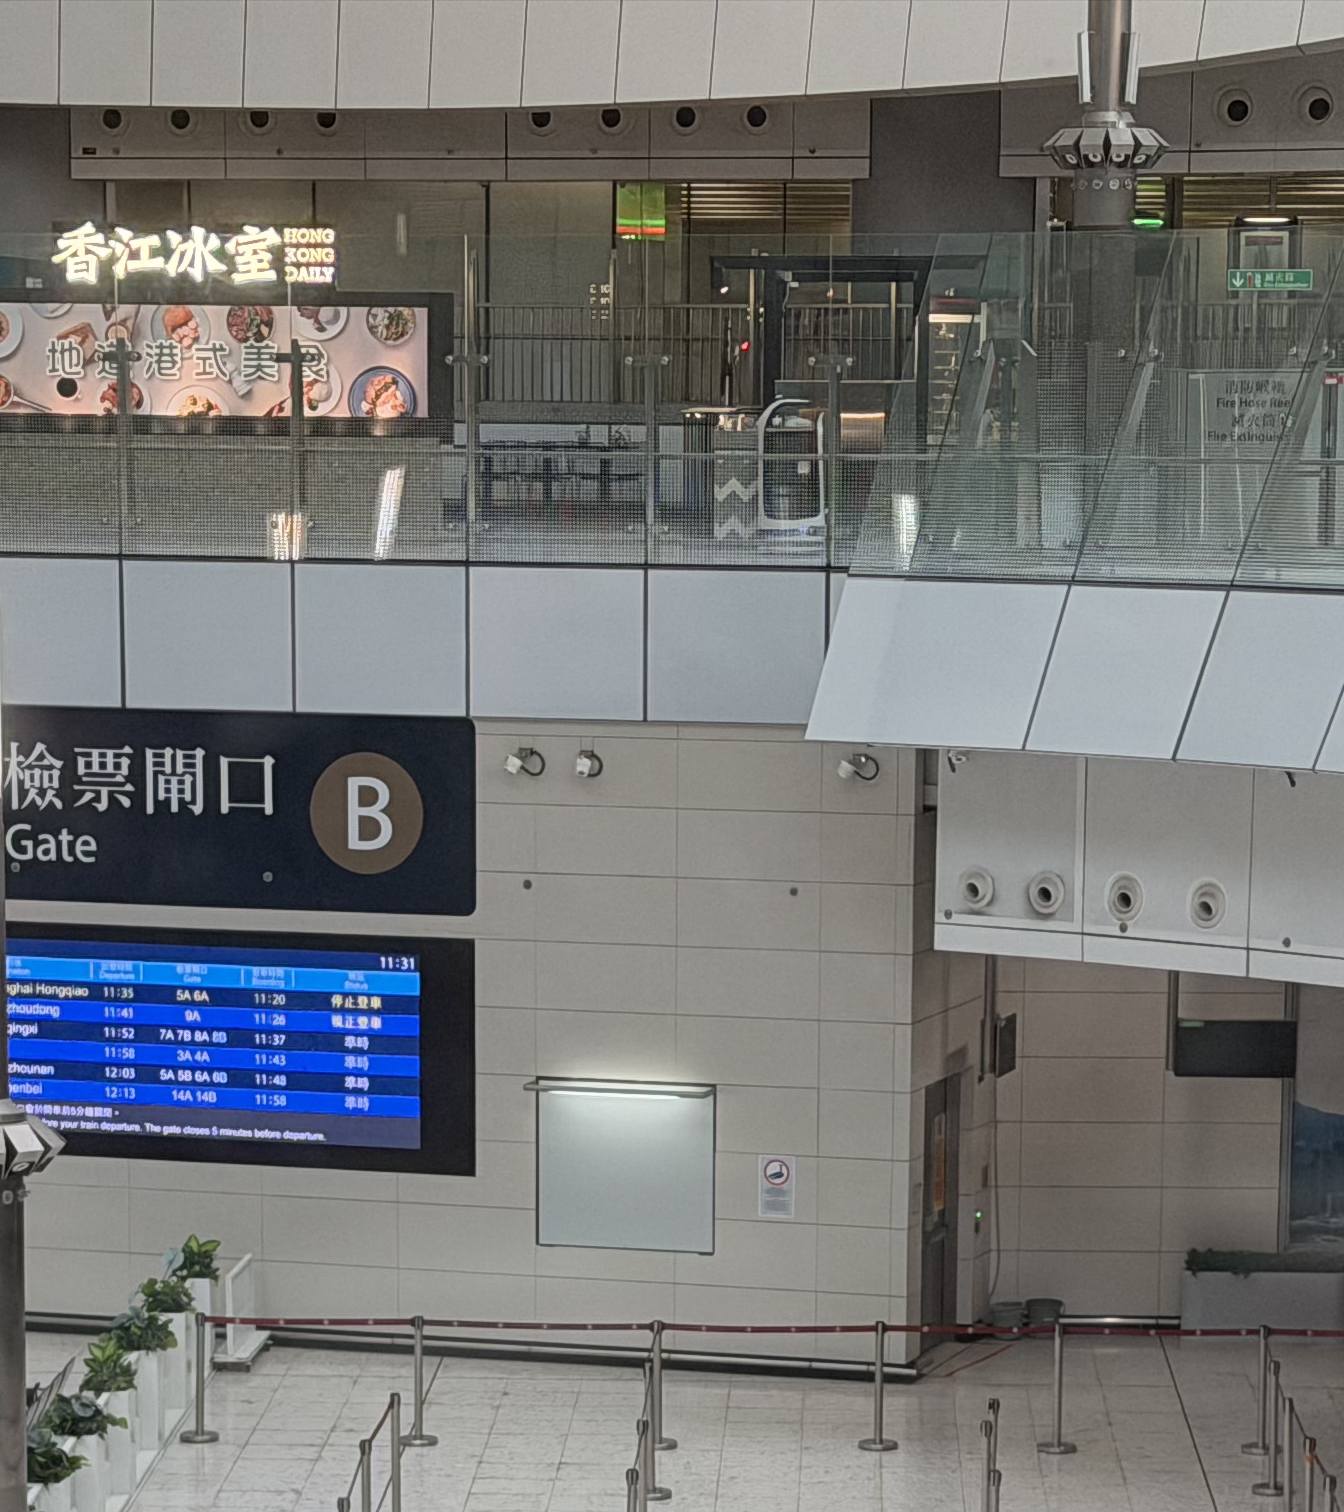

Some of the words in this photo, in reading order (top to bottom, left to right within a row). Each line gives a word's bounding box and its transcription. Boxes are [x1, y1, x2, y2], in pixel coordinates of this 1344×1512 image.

[283, 227, 335, 244] HONG
[51, 221, 282, 284] 香江冰室
[284, 247, 335, 264] KONG
[284, 266, 335, 284] DAILY
[1216, 397, 1236, 408] Fire
[1207, 430, 1227, 440] Fire
[4, 741, 276, 816] 檢票閘口
[346, 776, 394, 851] B
[5, 823, 98, 863] Gate
[380, 956, 415, 970] 11:31
[36, 983, 89, 998] Hongqiao
[103, 986, 134, 999] 11:35
[176, 989, 191, 1001] 5A
[193, 990, 209, 1003] 6A
[254, 993, 286, 1005] 11:20
[331, 995, 382, 1010] 停止登車
[104, 1006, 133, 1018] 11:41
[104, 1027, 135, 1039] 11:52
[160, 1029, 174, 1041] 7A
[178, 1030, 191, 1042] 7B
[194, 1031, 209, 1043] 8A
[254, 1034, 286, 1046] 11:37
[105, 1047, 135, 1059] 11:58
[177, 1050, 192, 1062] 3A
[194, 1051, 210, 1063] 4A
[255, 1053, 286, 1066] 11:43
[105, 1067, 136, 1079] 12:03
[195, 1071, 210, 1082] 6A
[255, 1074, 287, 1086] 11:48
[105, 1087, 136, 1099] 12:13
[172, 1089, 193, 1102] 14A
[256, 1094, 287, 1106] 11:58
[60, 1120, 78, 1130] your
[80, 1120, 99, 1130] train
[144, 1123, 161, 1133] The
[163, 1125, 181, 1135] gate
[220, 1128, 252, 1138] minutes
[255, 1128, 281, 1140] before
